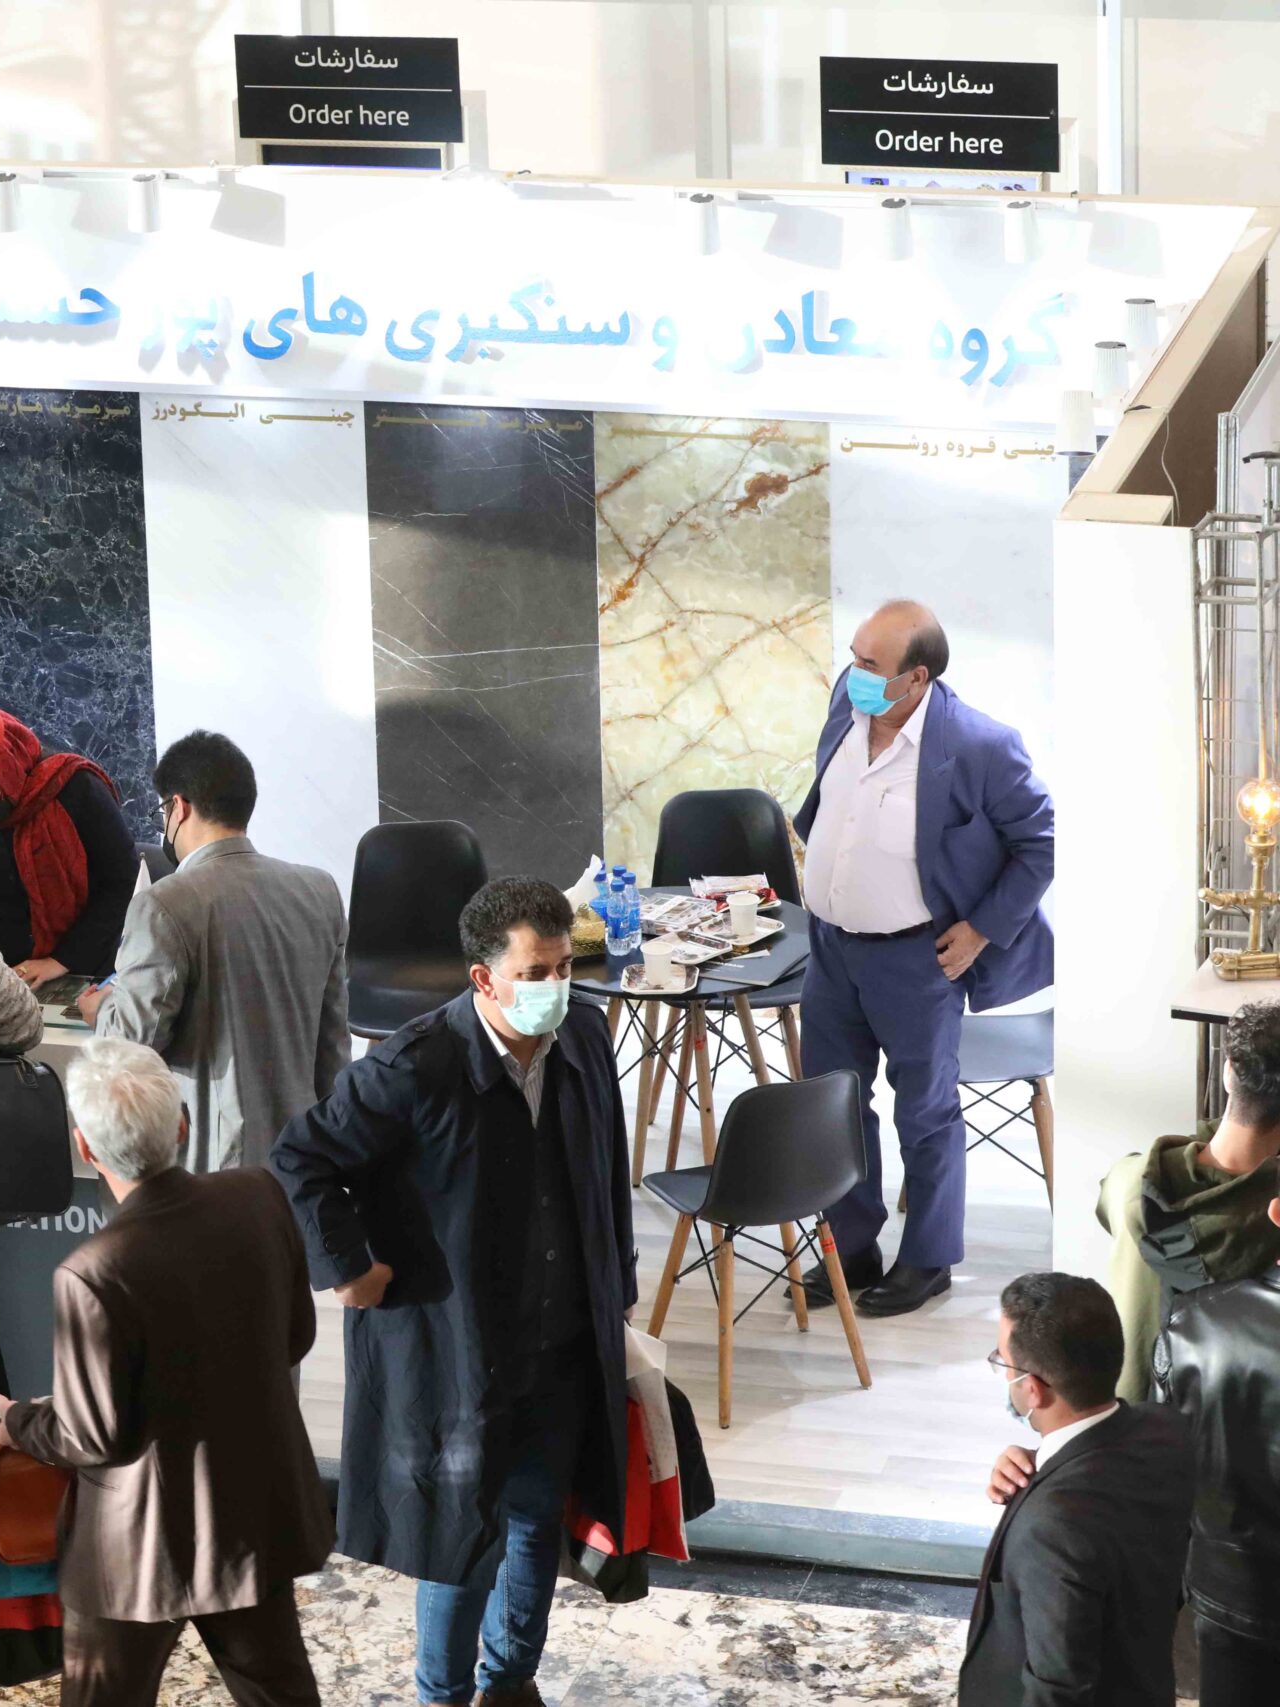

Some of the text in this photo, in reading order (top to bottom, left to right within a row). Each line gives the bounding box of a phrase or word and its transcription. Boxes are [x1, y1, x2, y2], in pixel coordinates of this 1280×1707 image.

[294, 47, 399, 74] سفارشات
[882, 70, 995, 99] سفارشات
[288, 104, 410, 126] Order here
[874, 129, 1004, 155] Order here
[242, 271, 368, 360] های
[259, 408, 355, 429] چینی
[839, 434, 940, 457] روشن
[945, 435, 997, 459] قروه
